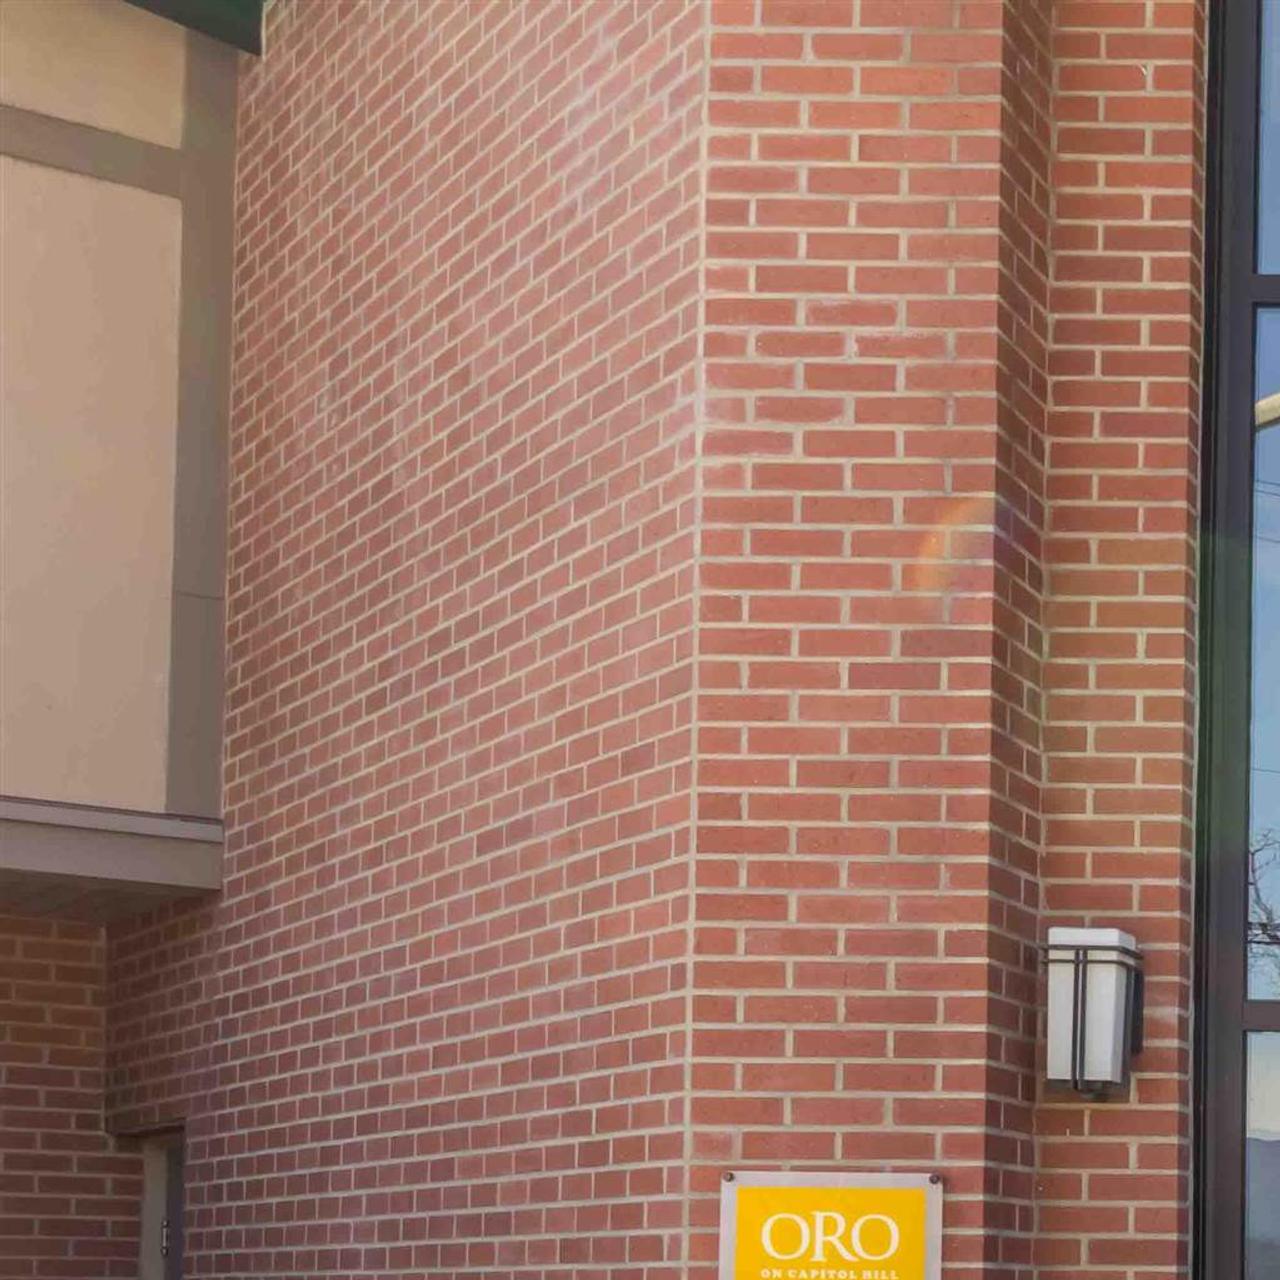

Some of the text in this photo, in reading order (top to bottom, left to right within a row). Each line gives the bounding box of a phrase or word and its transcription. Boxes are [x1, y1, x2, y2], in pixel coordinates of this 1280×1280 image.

[761, 1211, 900, 1262] ORO
[761, 1268, 899, 1280] ON CAPITOL HILL
